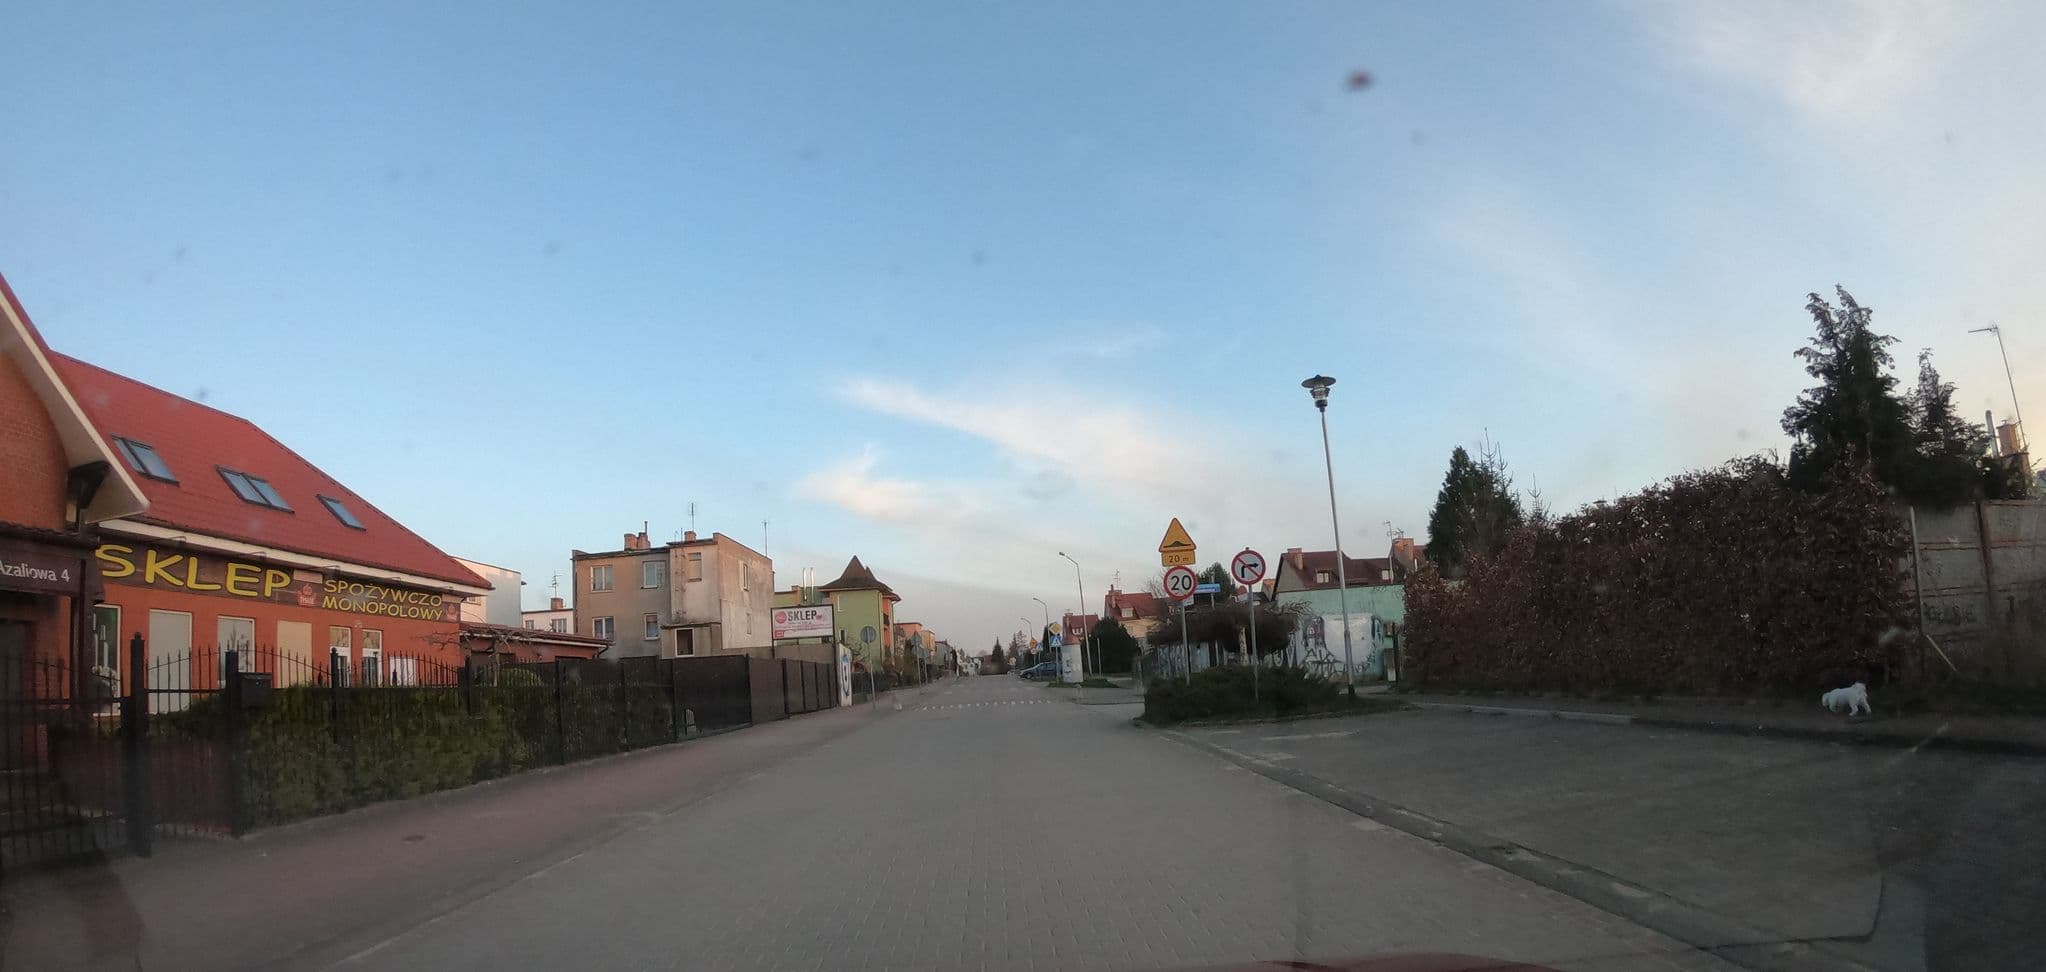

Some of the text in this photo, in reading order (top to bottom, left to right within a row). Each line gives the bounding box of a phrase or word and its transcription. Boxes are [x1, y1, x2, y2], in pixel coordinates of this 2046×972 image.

[1168, 555, 1180, 563] 20
[0, 560, 71, 583] Azaliowa 4
[95, 544, 291, 598] SKLEP
[1170, 574, 1192, 591] 20
[323, 580, 442, 607] SPOŻYWCZO
[322, 596, 442, 620] MONOPOLOWY
[788, 609, 817, 622] SKLEP
